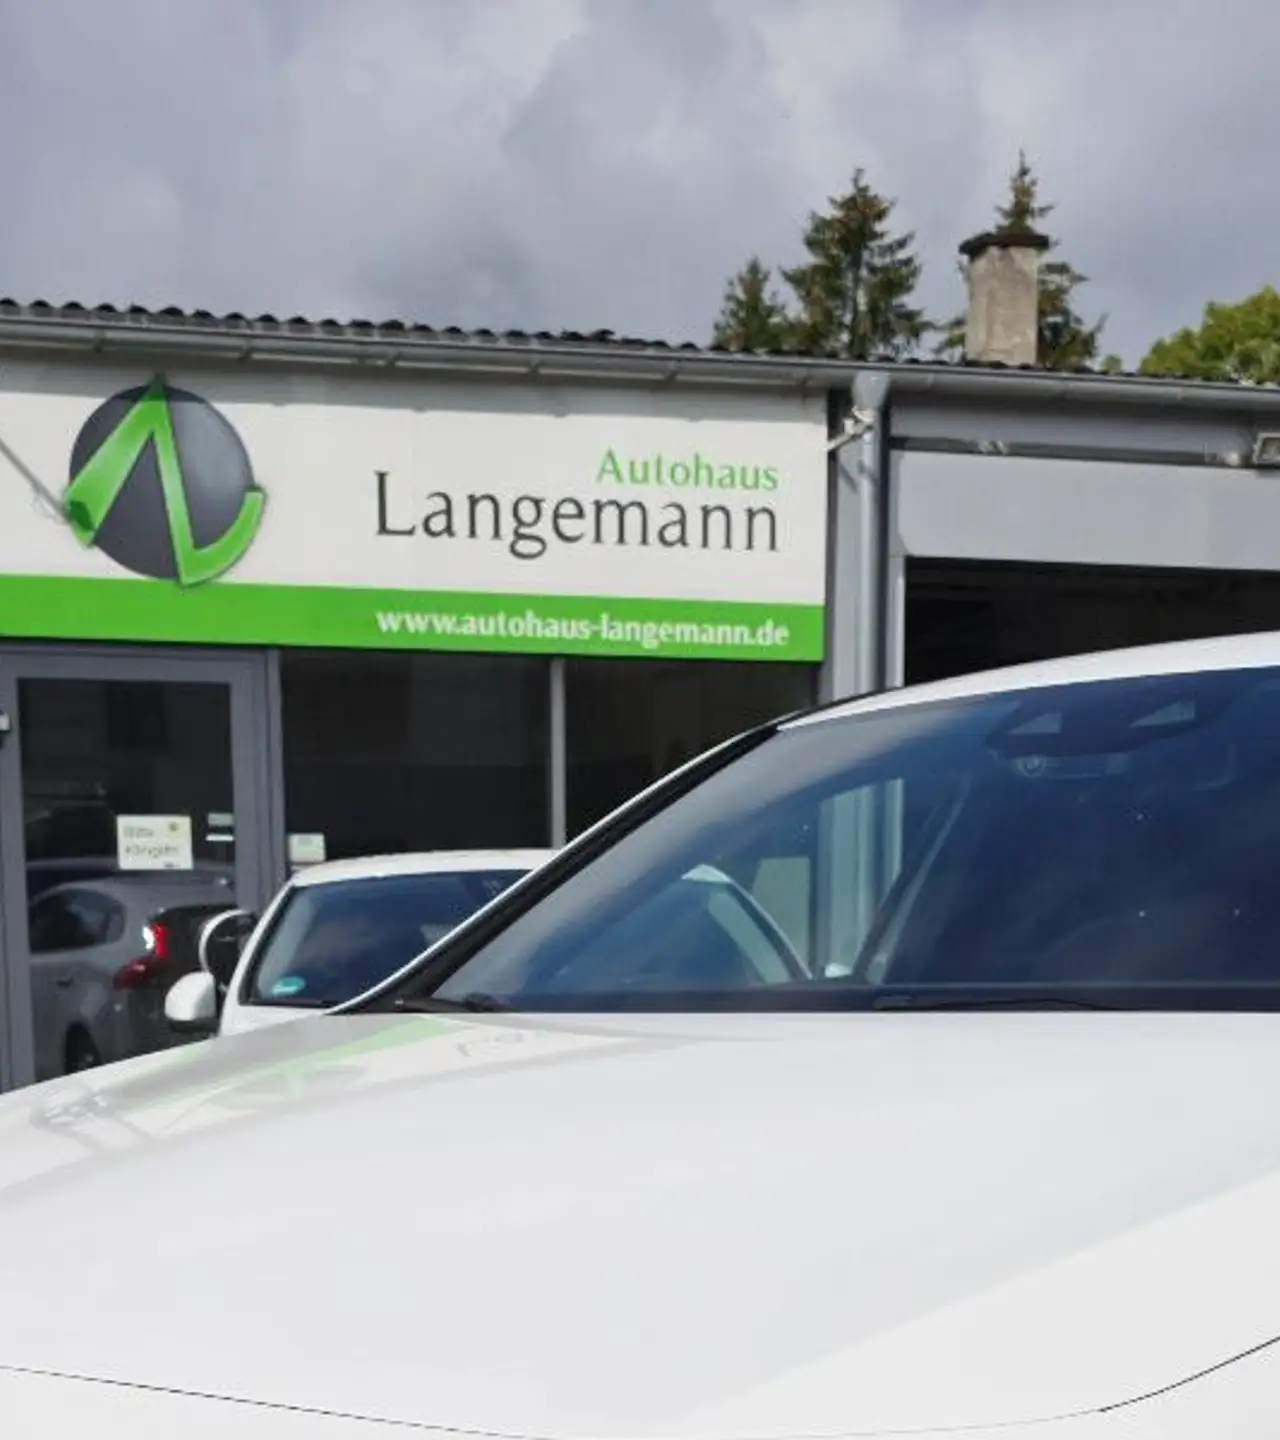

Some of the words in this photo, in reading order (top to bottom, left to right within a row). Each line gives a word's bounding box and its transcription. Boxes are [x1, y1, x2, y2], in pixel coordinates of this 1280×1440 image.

[596, 449, 779, 490] Autohaus
[374, 470, 780, 560] Langemann
[375, 609, 790, 649] www.autohaus-langemann.de
